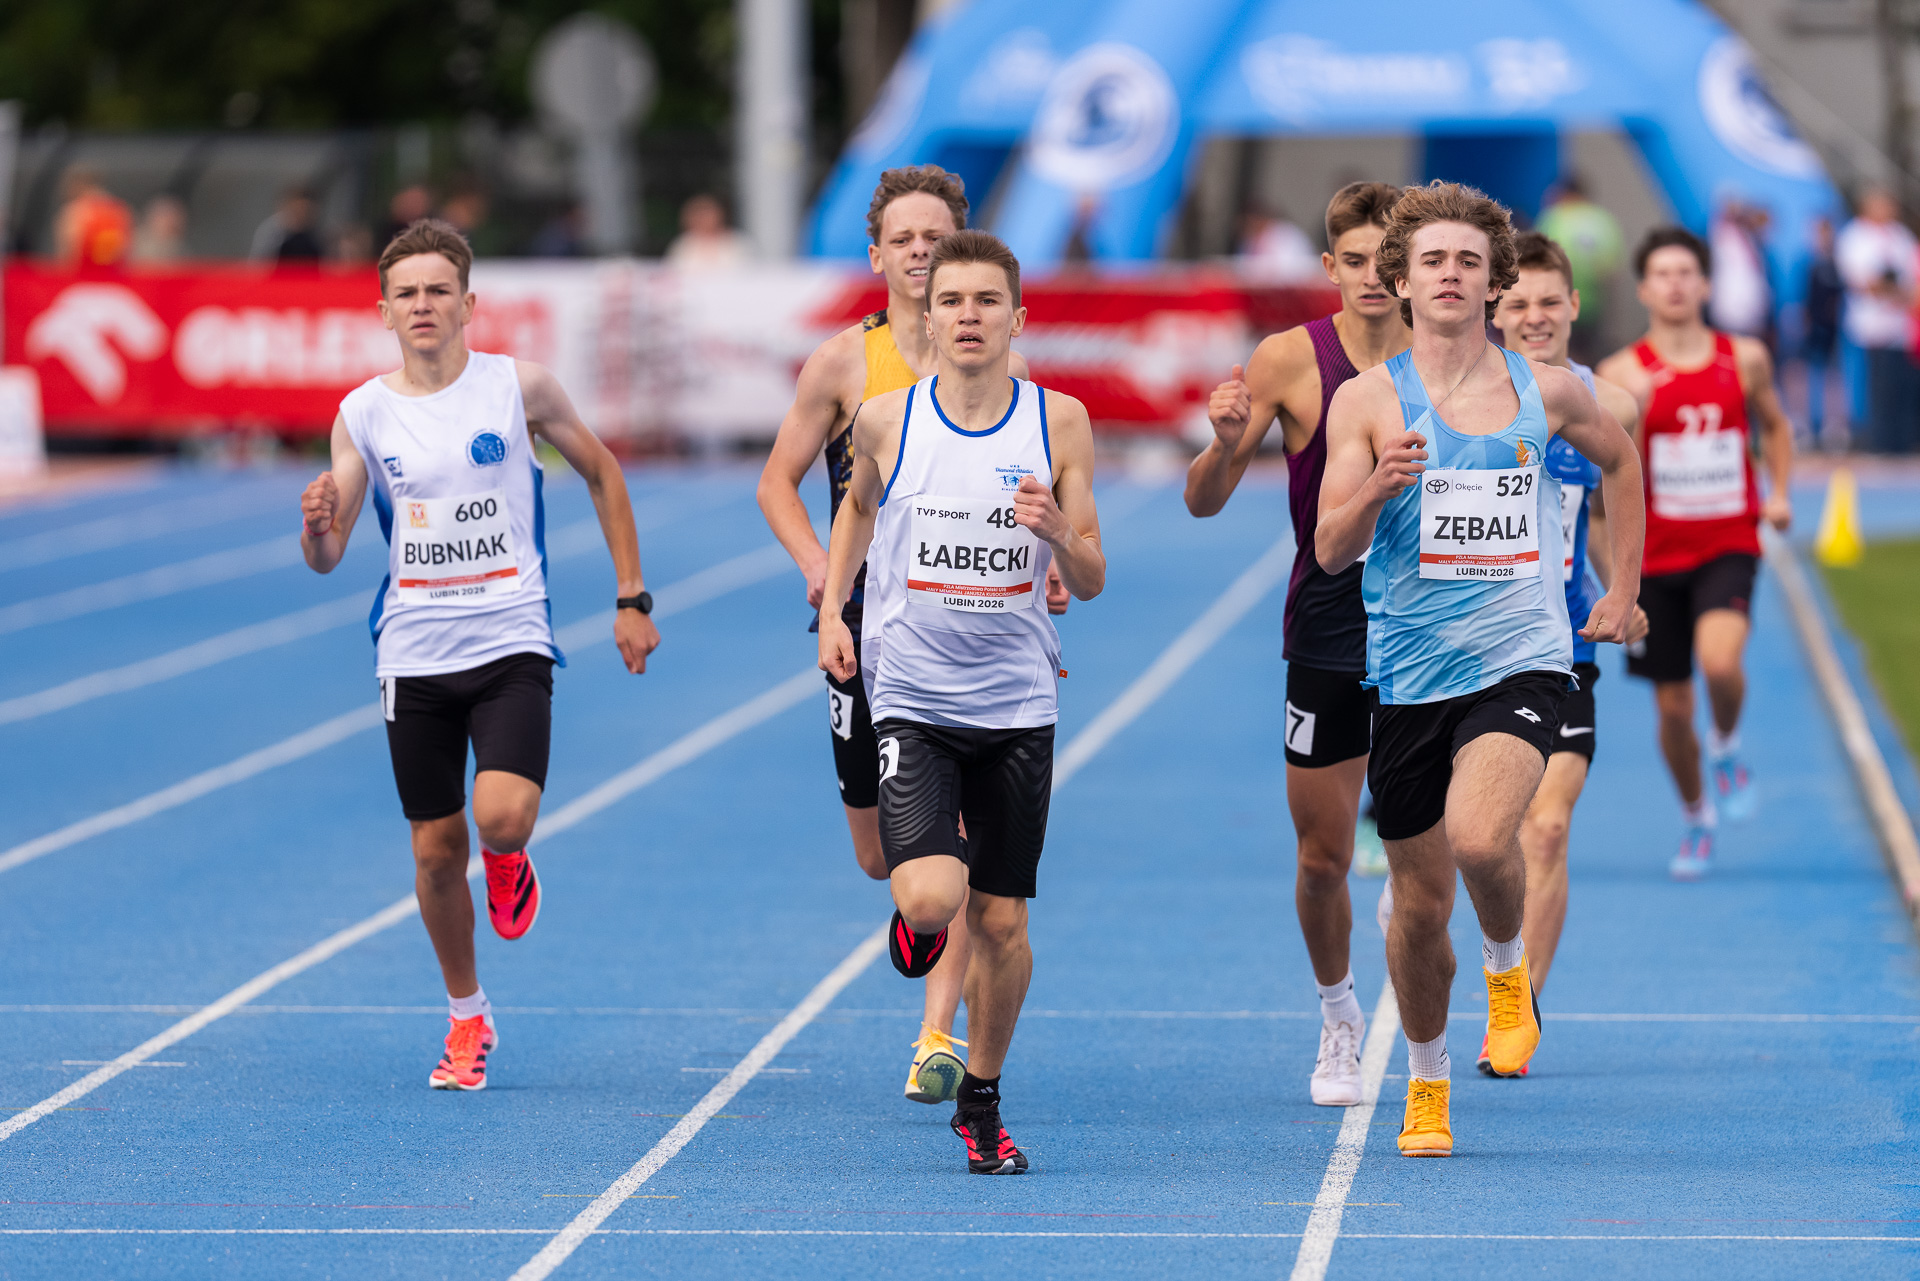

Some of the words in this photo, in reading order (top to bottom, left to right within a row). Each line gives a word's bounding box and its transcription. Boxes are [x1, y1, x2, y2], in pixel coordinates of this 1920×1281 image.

[1455, 483, 1483, 493] Okęcie
[1496, 473, 1533, 497] 529
[455, 498, 497, 522] 600
[916, 507, 937, 518] TVP
[938, 509, 971, 520] SPORT
[986, 507, 1018, 529] 48
[1433, 514, 1529, 545] ZĘBALA
[404, 532, 507, 565] BUBNIAK
[917, 541, 1030, 576] ŁABĘCKI
[1456, 567, 1488, 577] LUBIN
[1489, 567, 1514, 577] 2026
[430, 589, 459, 598] LUBIN
[462, 586, 486, 596] 2026
[943, 597, 975, 608] LUBIN
[977, 599, 1004, 609] 2026
[831, 693, 843, 730] 3
[1289, 708, 1305, 745] 7
